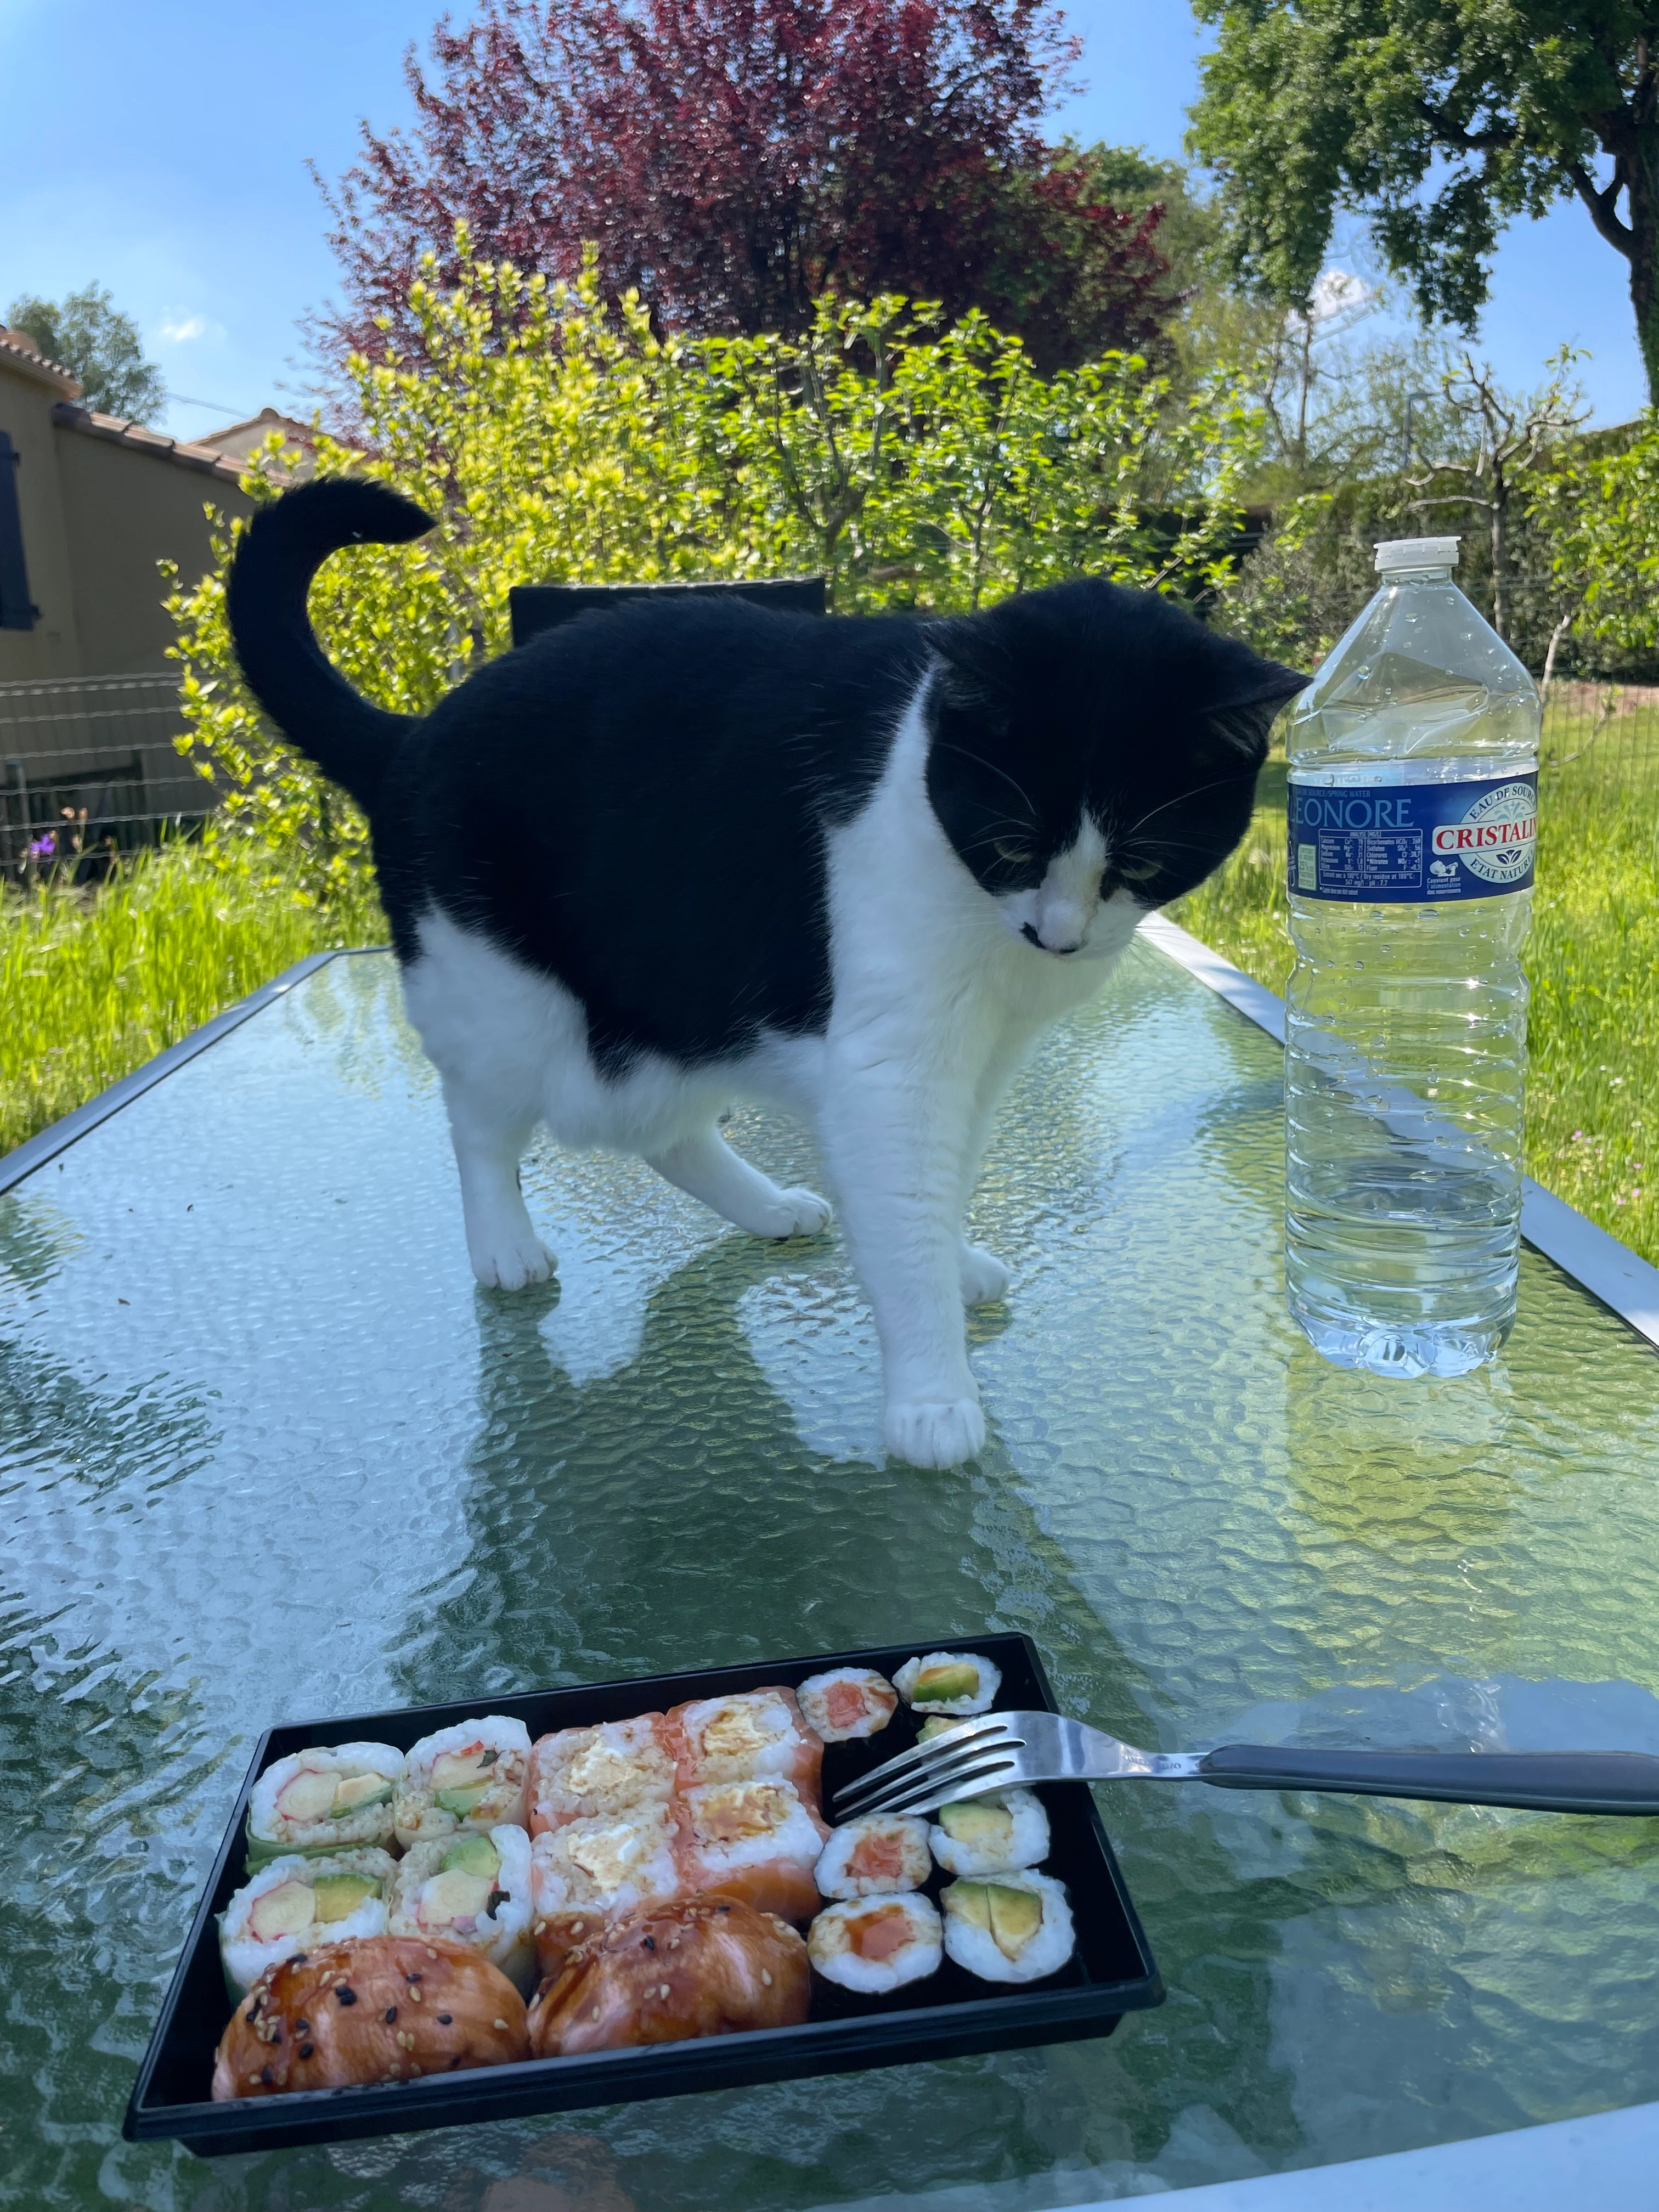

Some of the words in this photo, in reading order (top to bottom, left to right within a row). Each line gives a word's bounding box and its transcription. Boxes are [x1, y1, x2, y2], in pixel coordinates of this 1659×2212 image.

[1469, 795, 1493, 820] EAU
[1496, 787, 1510, 801] DE
[1470, 858, 1498, 878] ETAT
